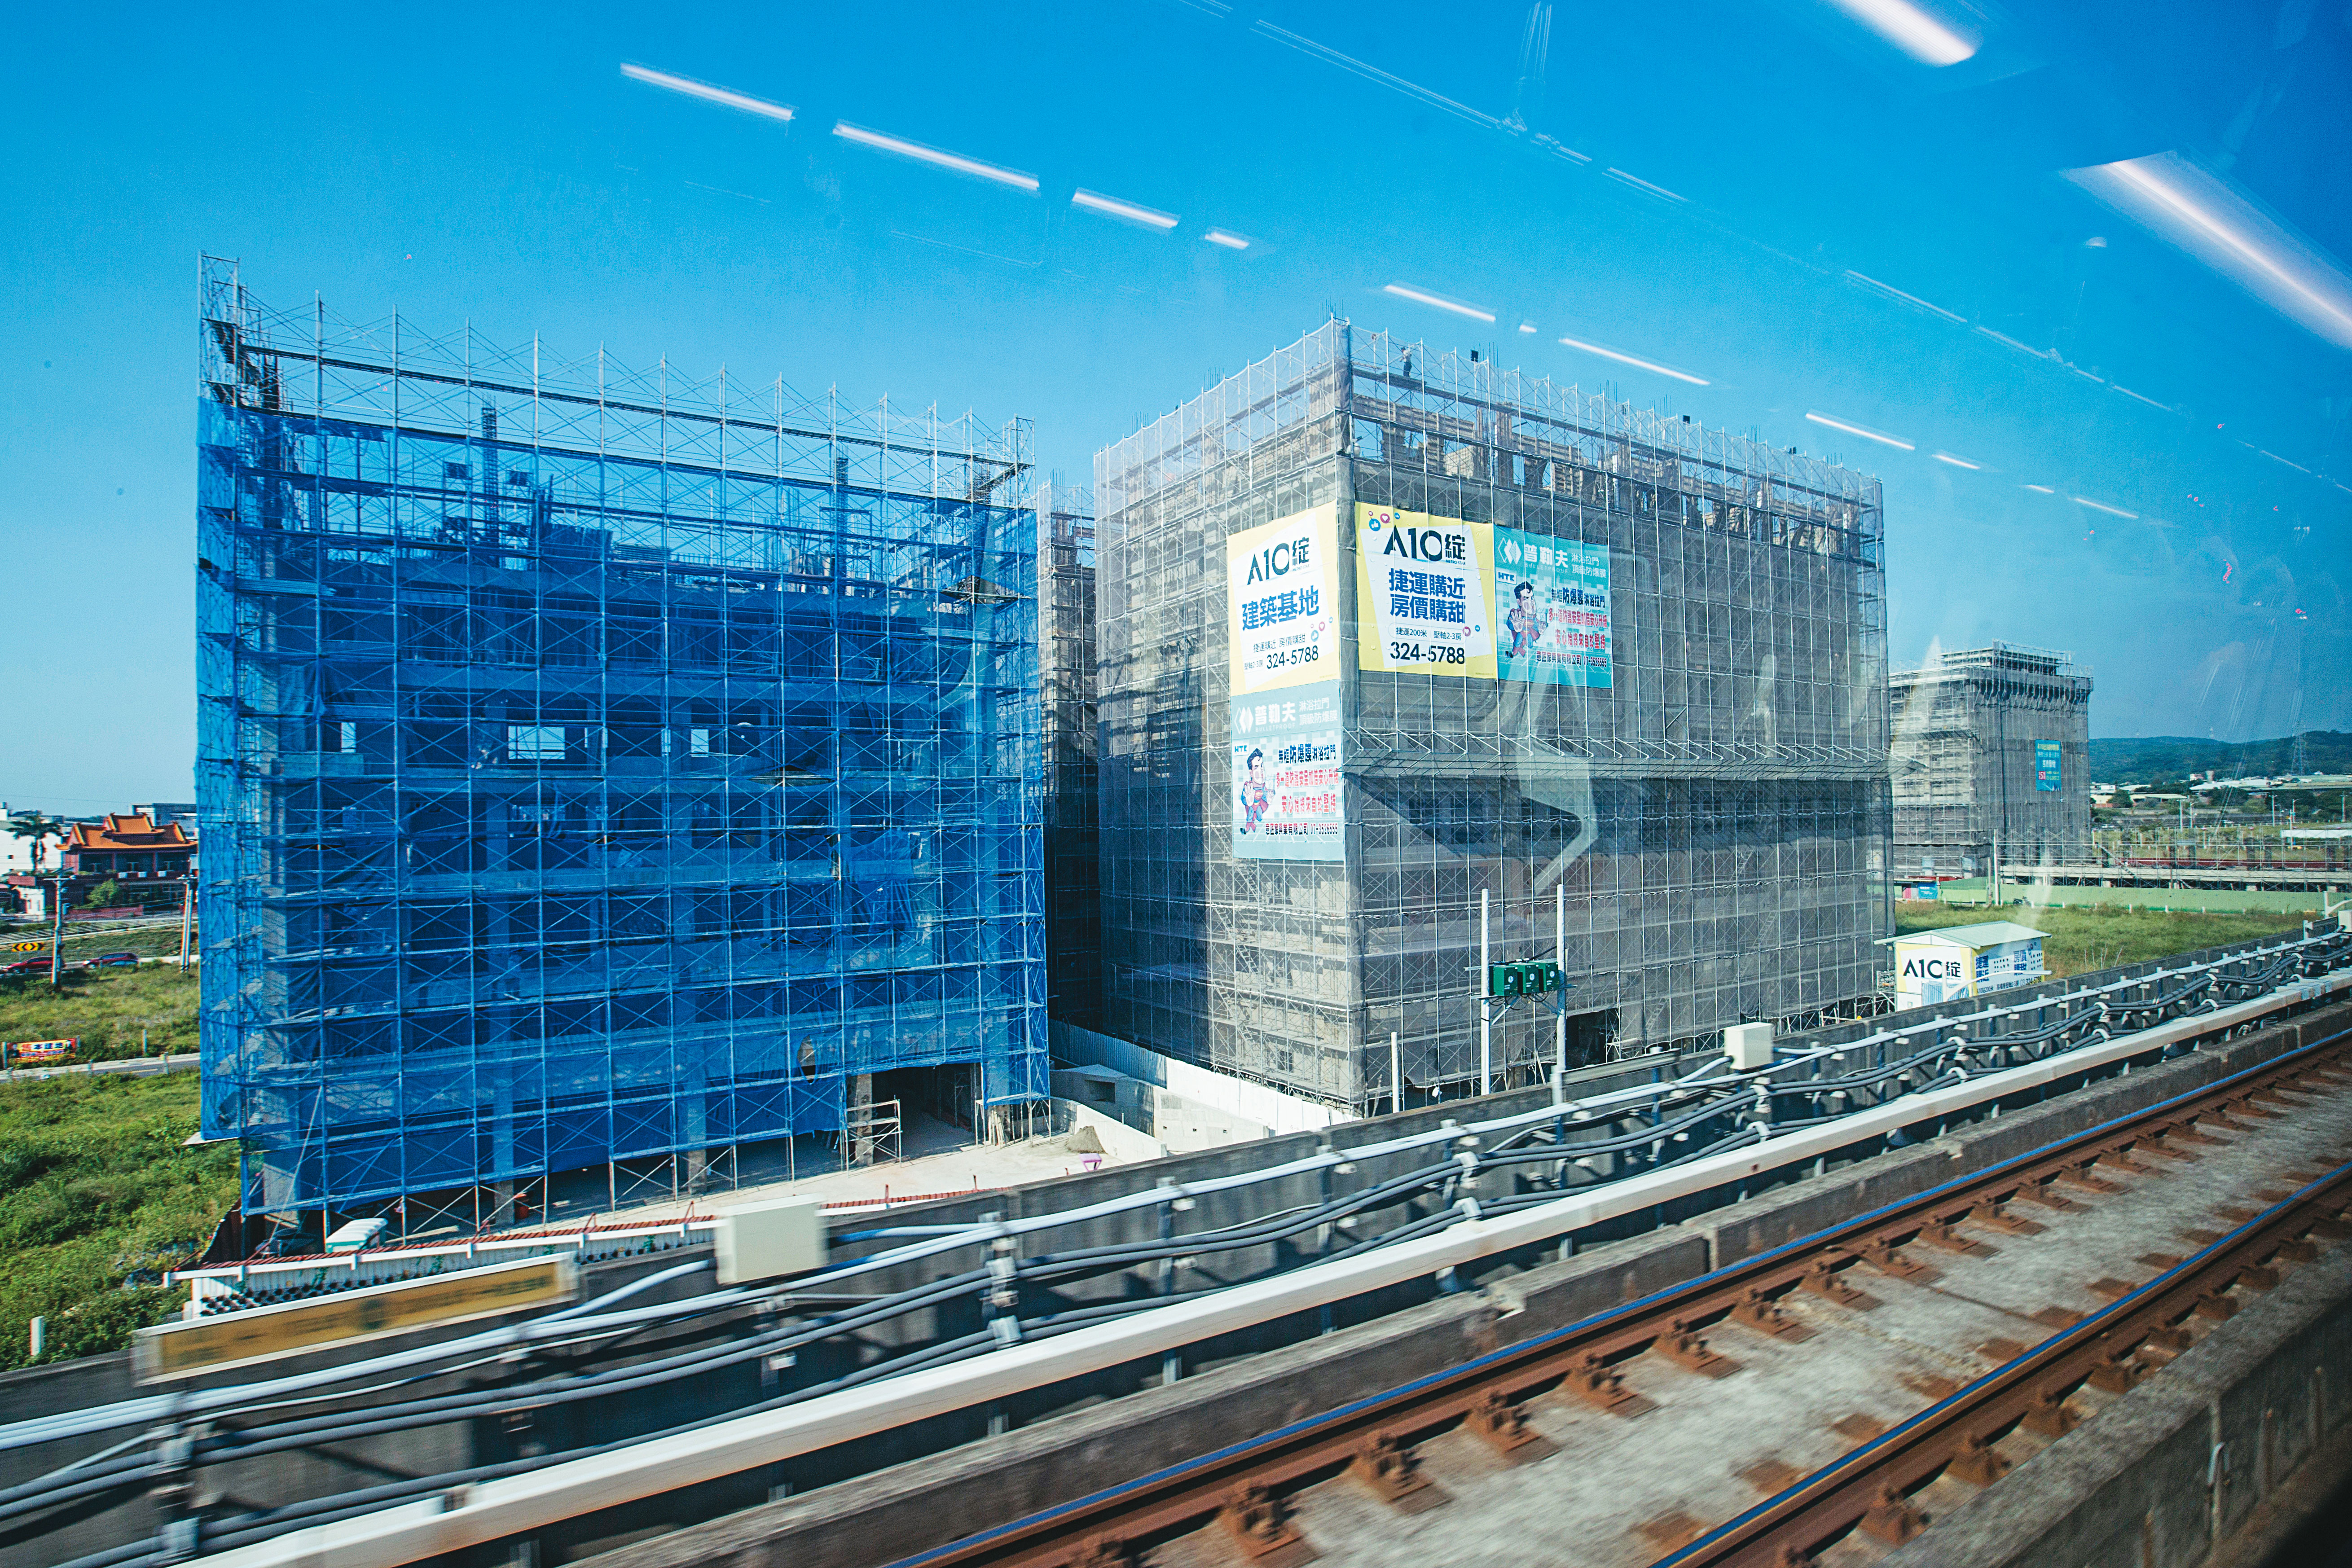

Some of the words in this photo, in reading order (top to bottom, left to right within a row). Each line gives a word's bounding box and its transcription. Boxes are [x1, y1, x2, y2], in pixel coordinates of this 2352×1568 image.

[1389, 568, 1466, 599] 捷運購近
[1242, 585, 1319, 631] 建築基地
[1390, 594, 1466, 623] 房價購甜
[1396, 627, 1427, 637] 捷運200米
[1267, 645, 1319, 669] 324-5788
[1390, 641, 1465, 664] 324-5788
